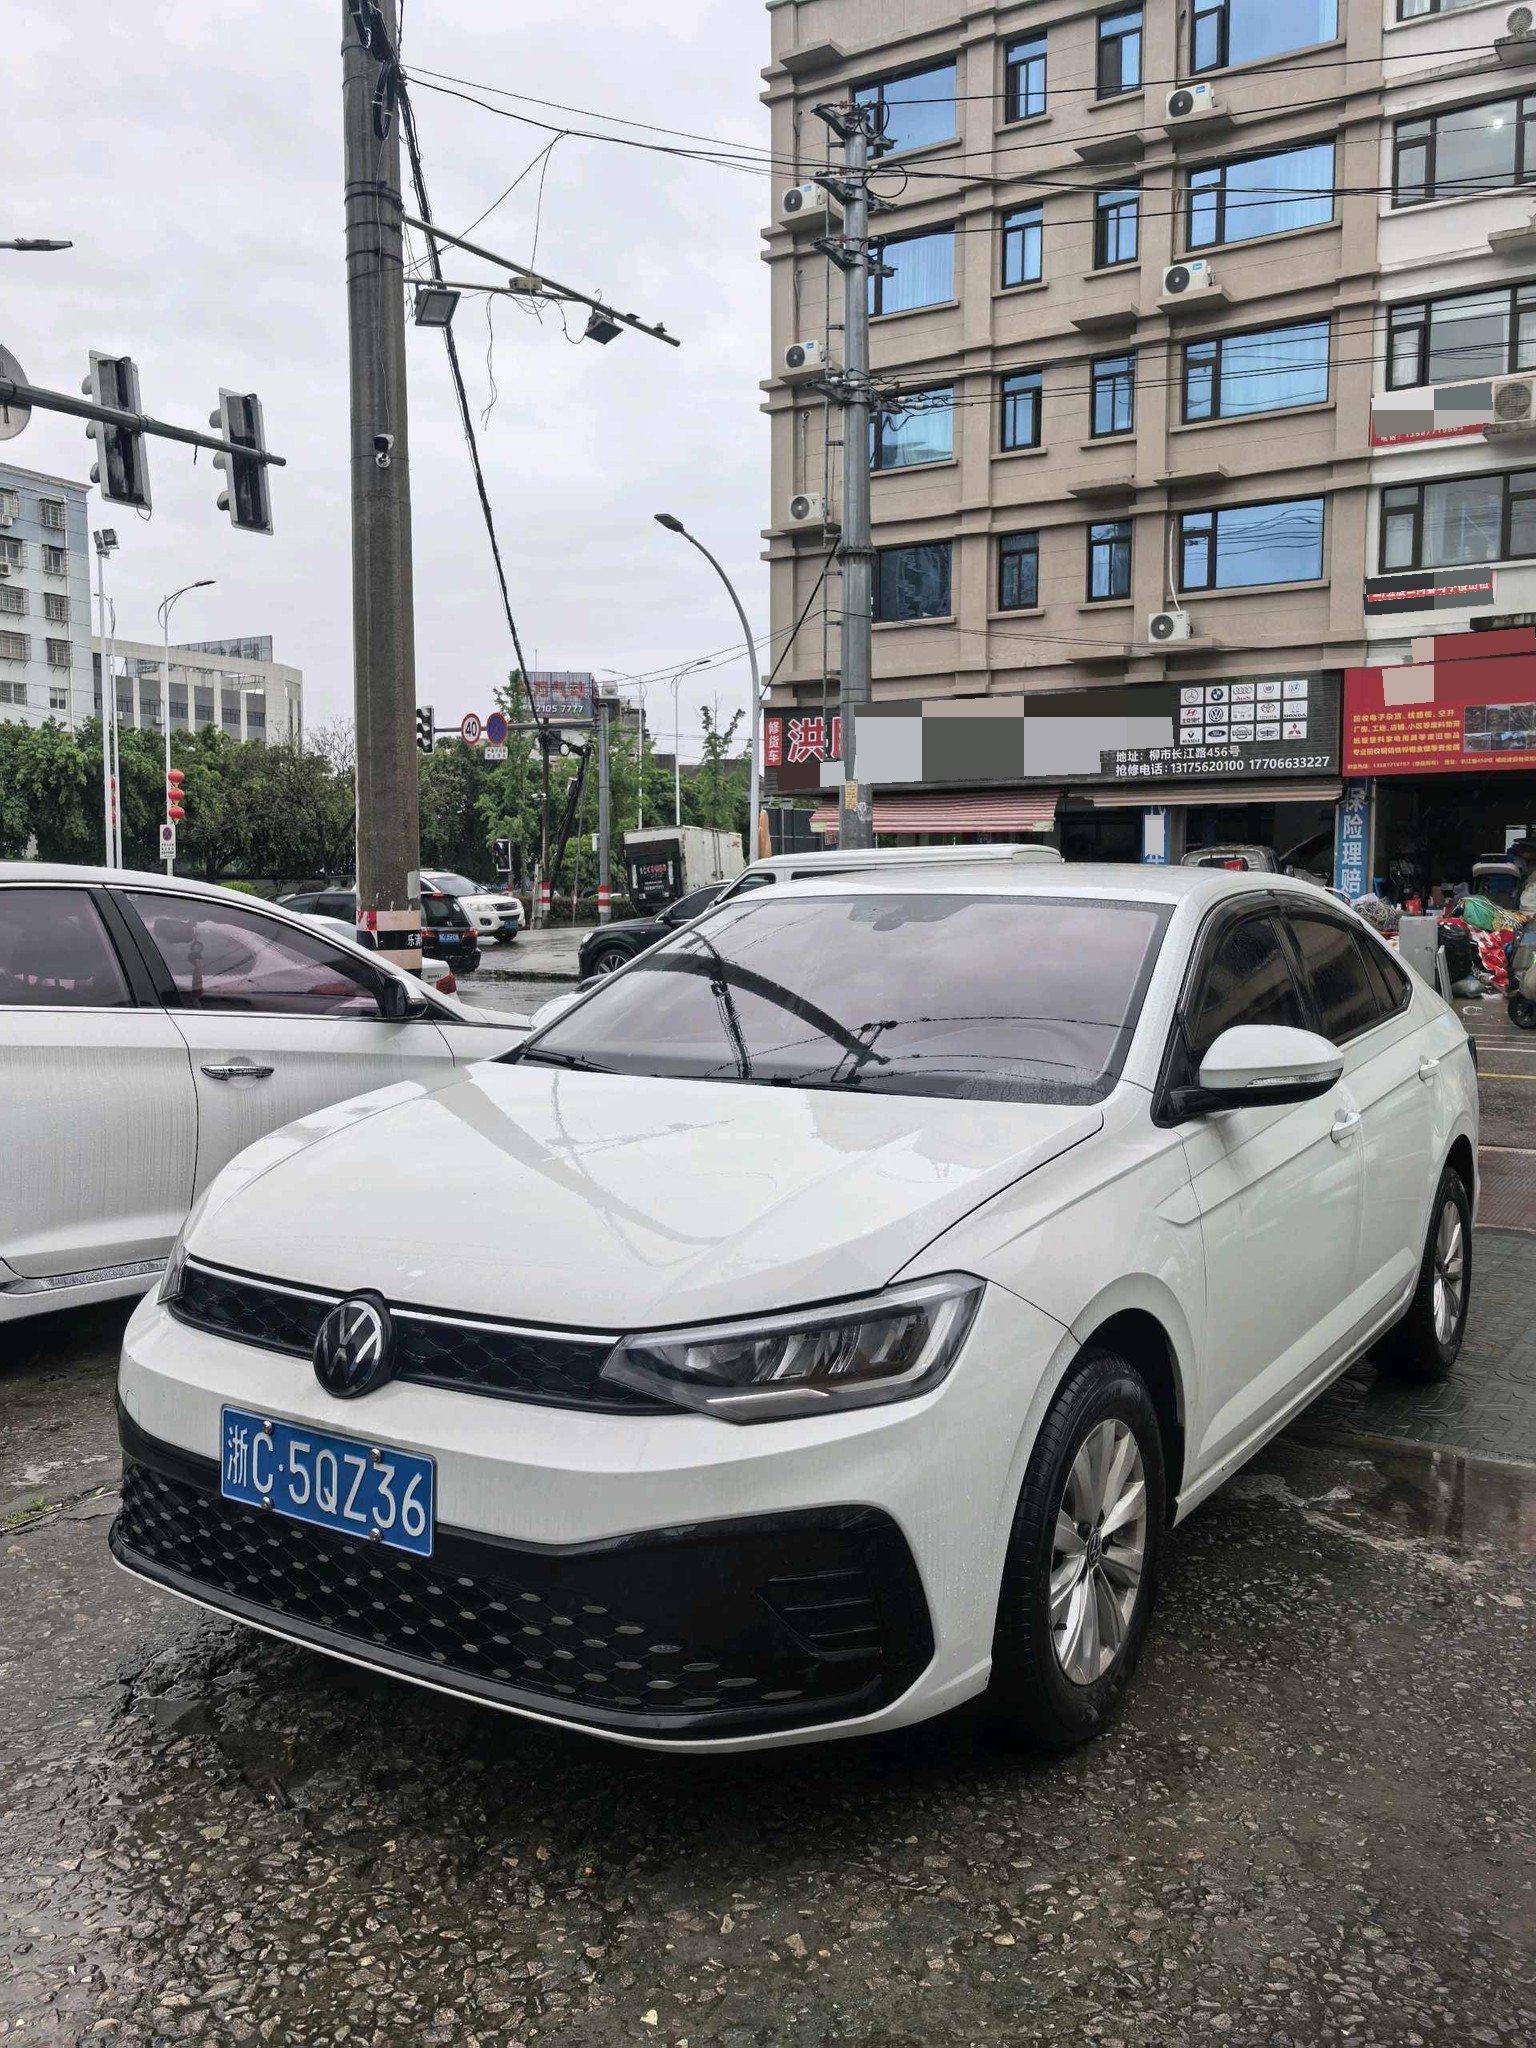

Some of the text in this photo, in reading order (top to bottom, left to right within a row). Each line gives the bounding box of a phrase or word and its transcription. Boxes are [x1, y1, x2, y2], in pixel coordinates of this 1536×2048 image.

[536, 704, 584, 713] 2105 7777
[465, 721, 477, 737] 40
[768, 721, 780, 763] 修货车
[1248, 756, 1330, 770] 17706633227
[1341, 787, 1365, 894] 保险理赔
[226, 1424, 426, 1538] 浙C·5QZ36
